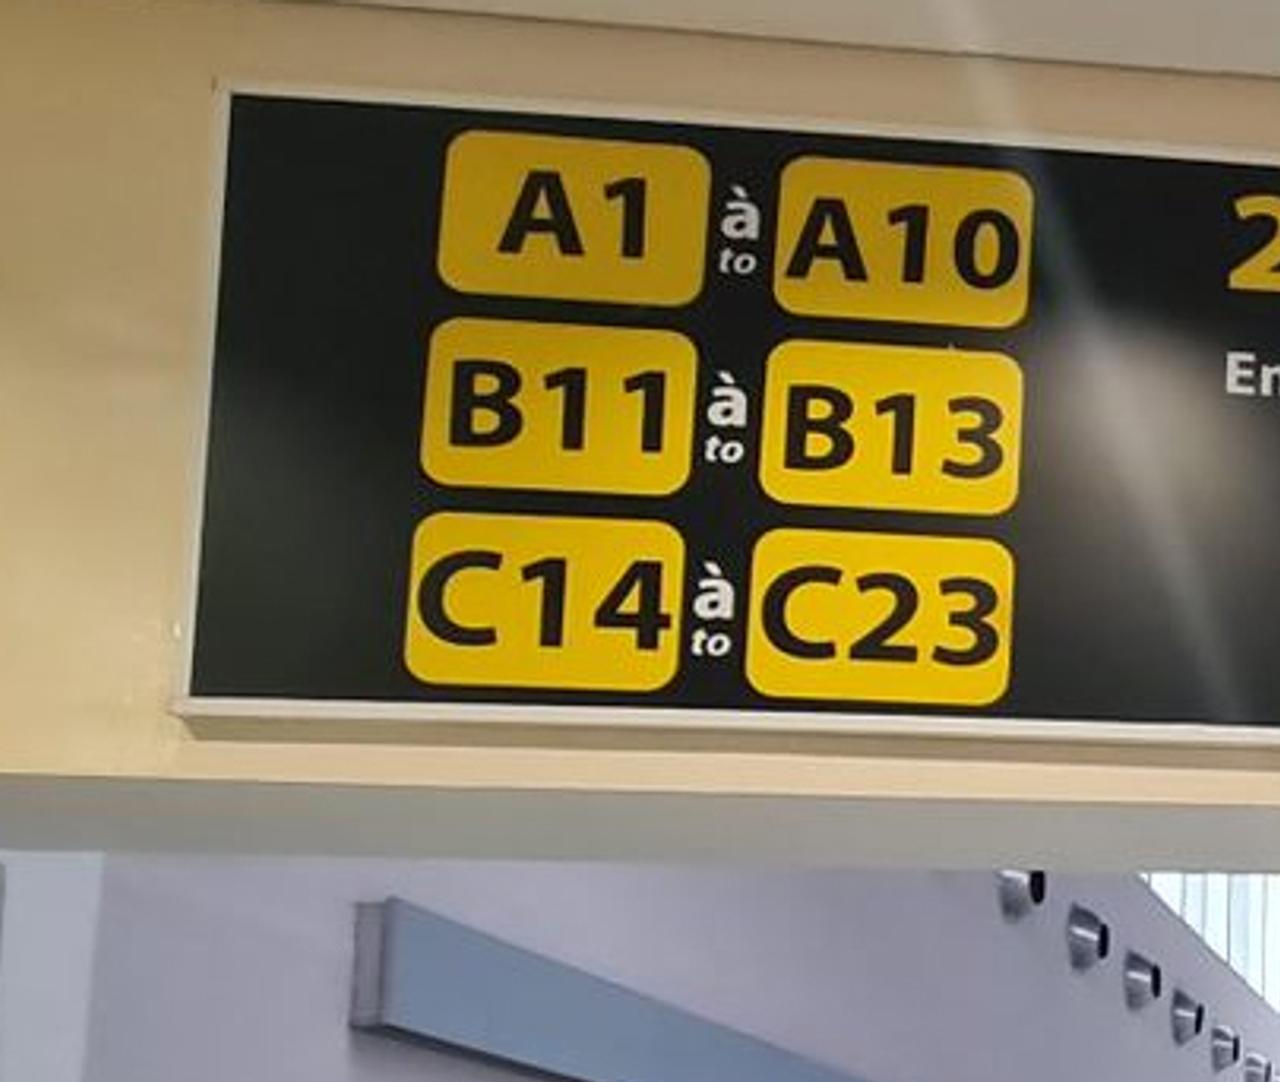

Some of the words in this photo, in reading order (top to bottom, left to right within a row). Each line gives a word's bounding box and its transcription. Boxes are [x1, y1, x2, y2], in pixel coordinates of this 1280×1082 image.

[497, 170, 648, 259] A1
[720, 187, 763, 245] à
[784, 197, 1020, 291] A10
[718, 247, 757, 277] to
[447, 359, 669, 453] B11
[706, 372, 748, 428] à
[783, 384, 1006, 480] B13
[704, 436, 745, 464] to
[417, 550, 672, 651] C14
[693, 563, 736, 622] à
[760, 566, 1002, 667] C23
[690, 628, 732, 658] to
